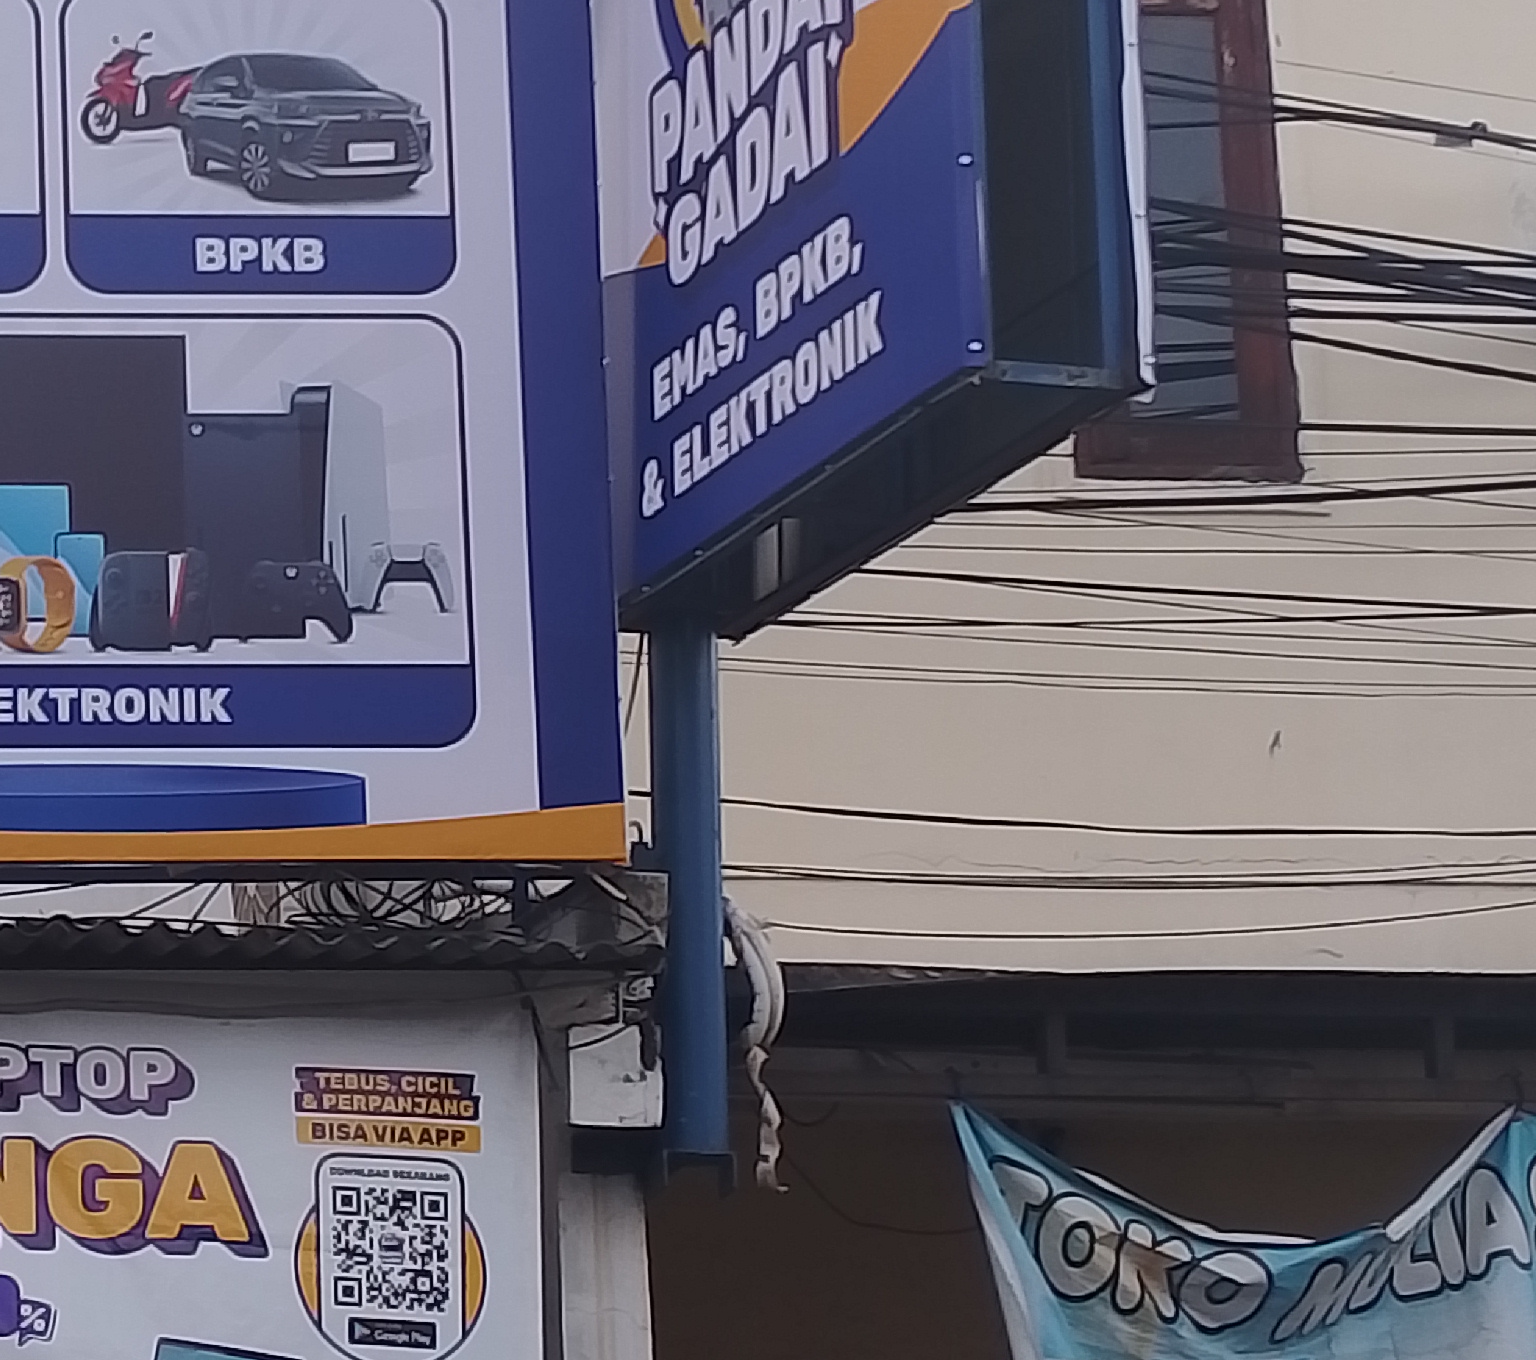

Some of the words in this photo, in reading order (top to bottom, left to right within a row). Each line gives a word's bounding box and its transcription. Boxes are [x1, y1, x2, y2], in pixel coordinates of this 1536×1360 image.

[667, 48, 830, 285] GADAI
[194, 235, 326, 274] BPKB
[652, 306, 747, 421] EMAS,
[755, 215, 863, 341] BPKB,
[641, 459, 664, 519] &
[672, 290, 883, 498] ELEKTRONIK
[302, 1093, 317, 1110] &
[322, 1094, 475, 1117] PERPANJANG
[311, 1122, 368, 1143] BISA
[372, 1125, 415, 1145] VIA
[417, 1127, 467, 1148] APP
[401, 1074, 462, 1095] CICIL
[989, 1155, 1272, 1333] TOKO
